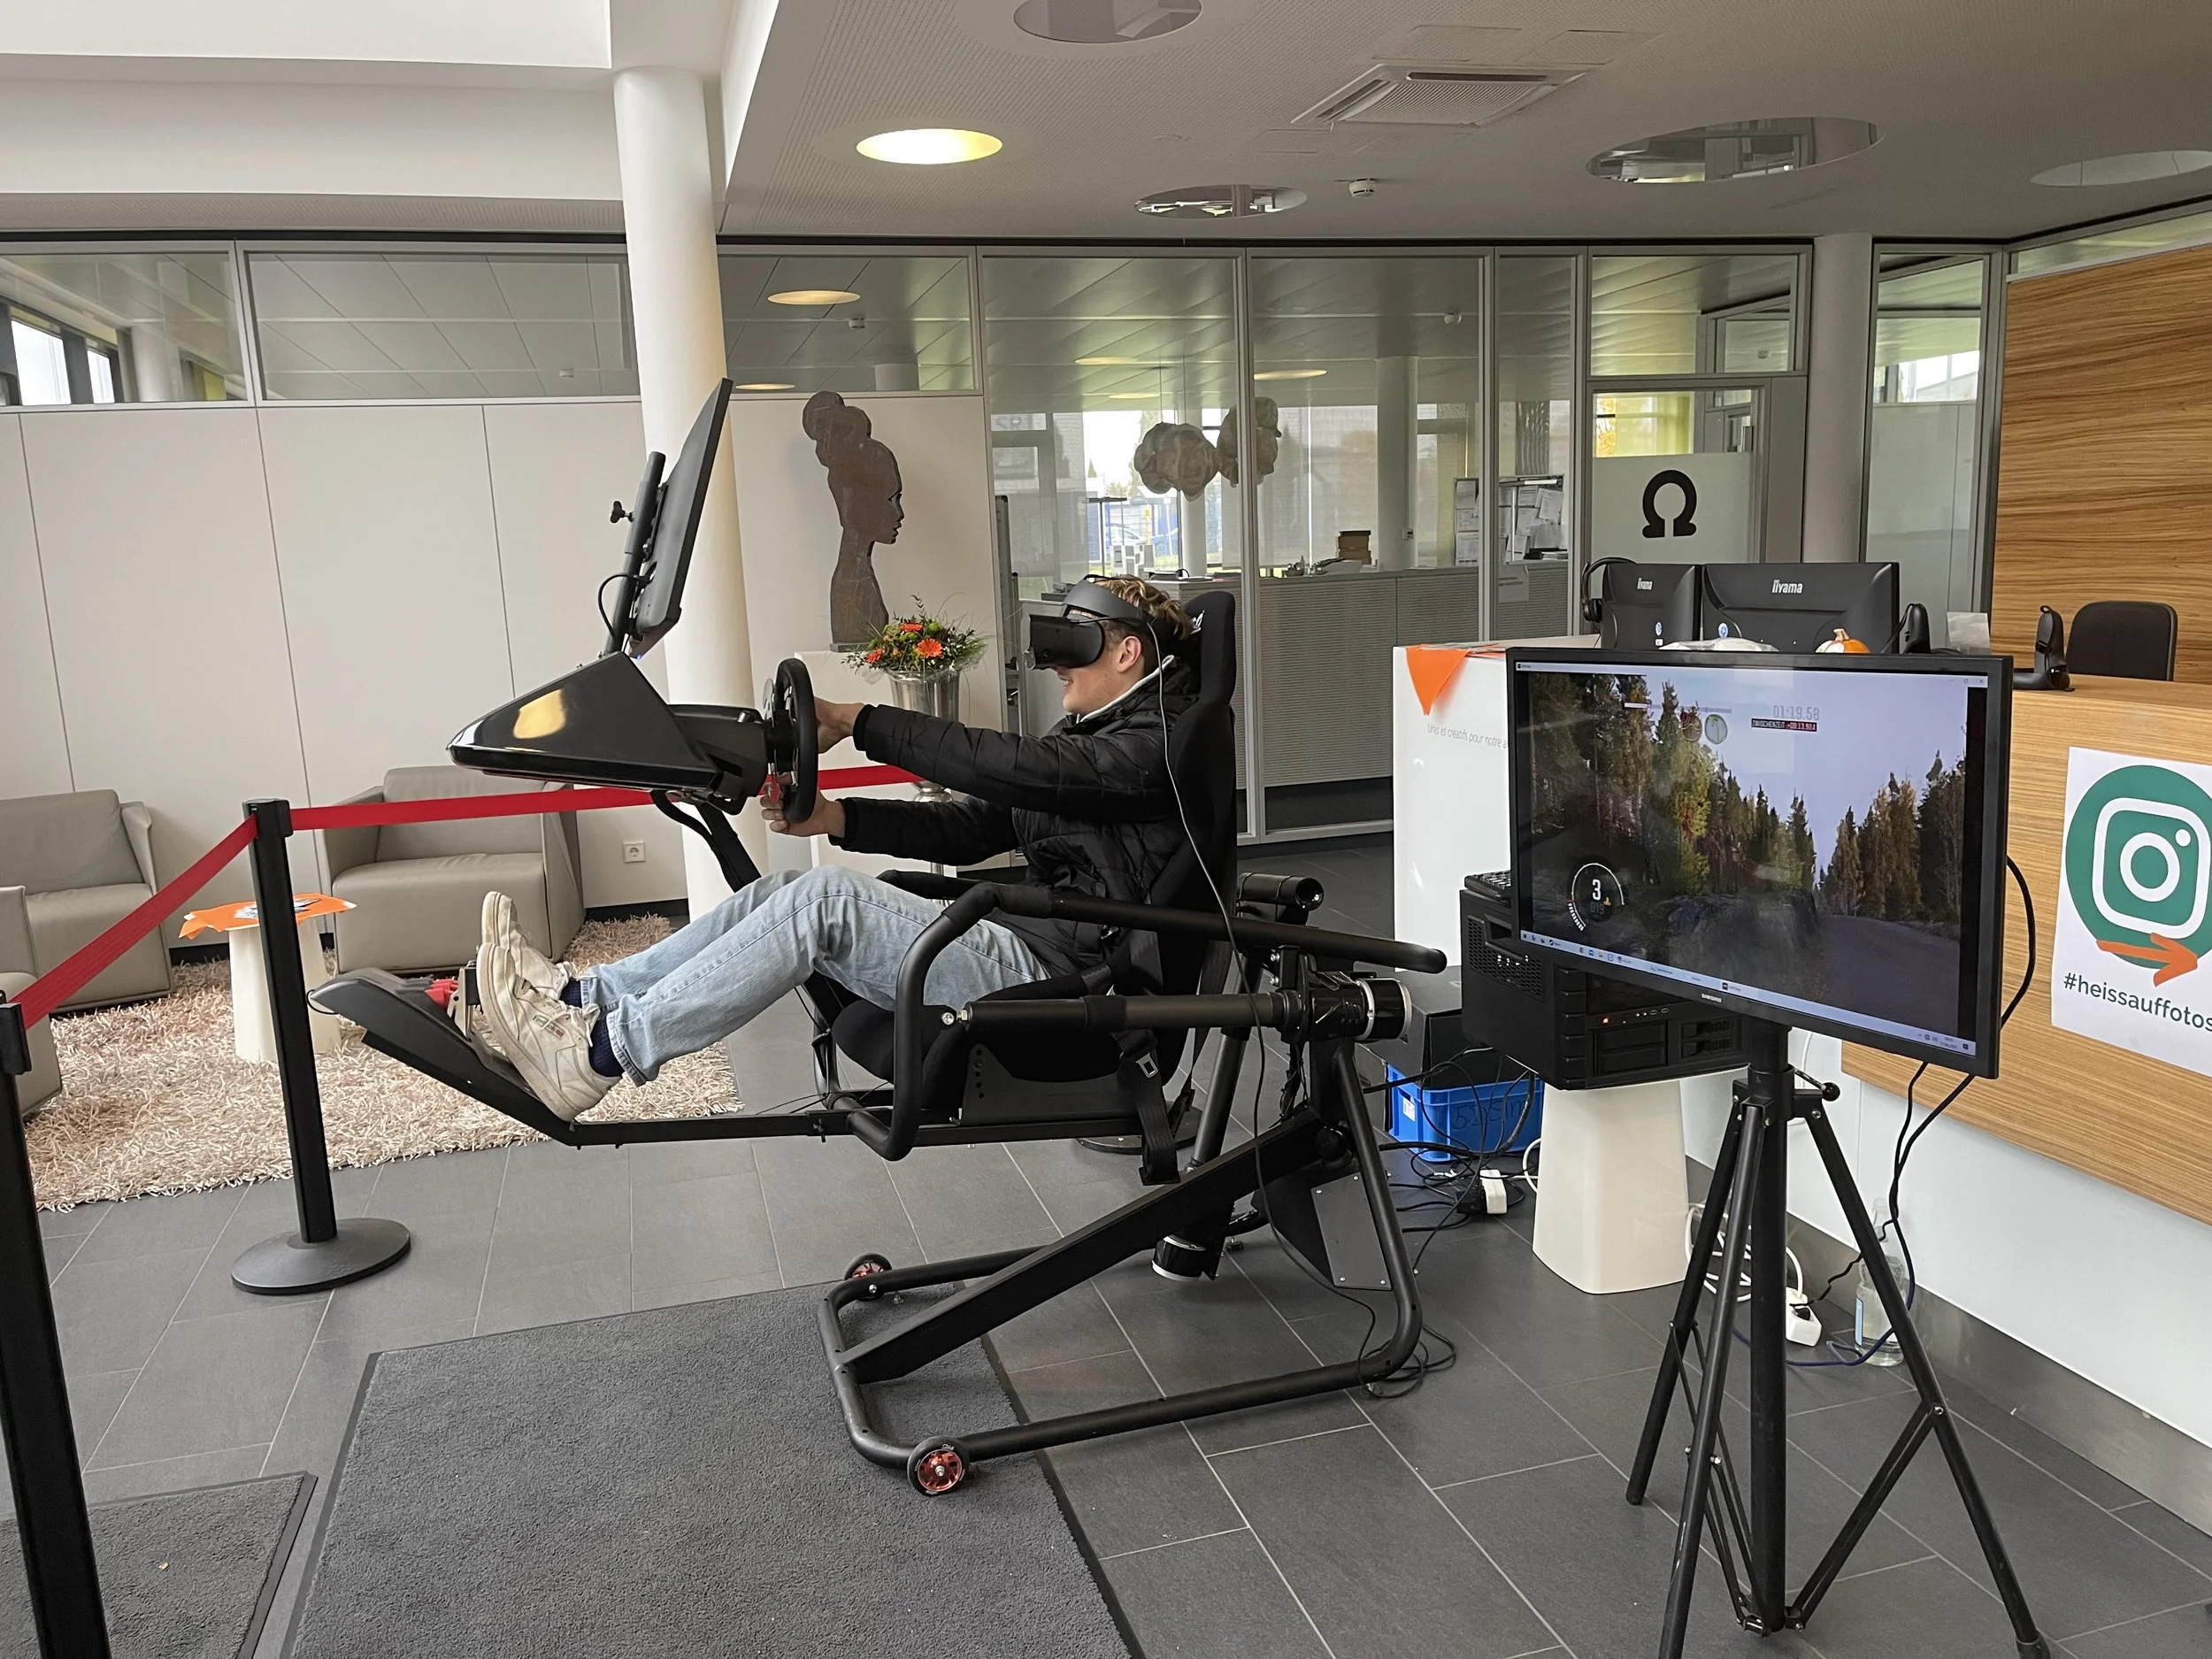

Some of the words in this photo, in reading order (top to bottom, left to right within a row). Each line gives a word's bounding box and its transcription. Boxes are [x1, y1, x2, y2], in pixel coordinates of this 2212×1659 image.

[1771, 579, 1803, 594] iiyama
[1427, 723, 1440, 735] Unis
[1440, 726, 1447, 736] et
[1469, 733, 1484, 744] pour
[1485, 735, 1502, 748] notre
[1592, 879, 1601, 901] 3
